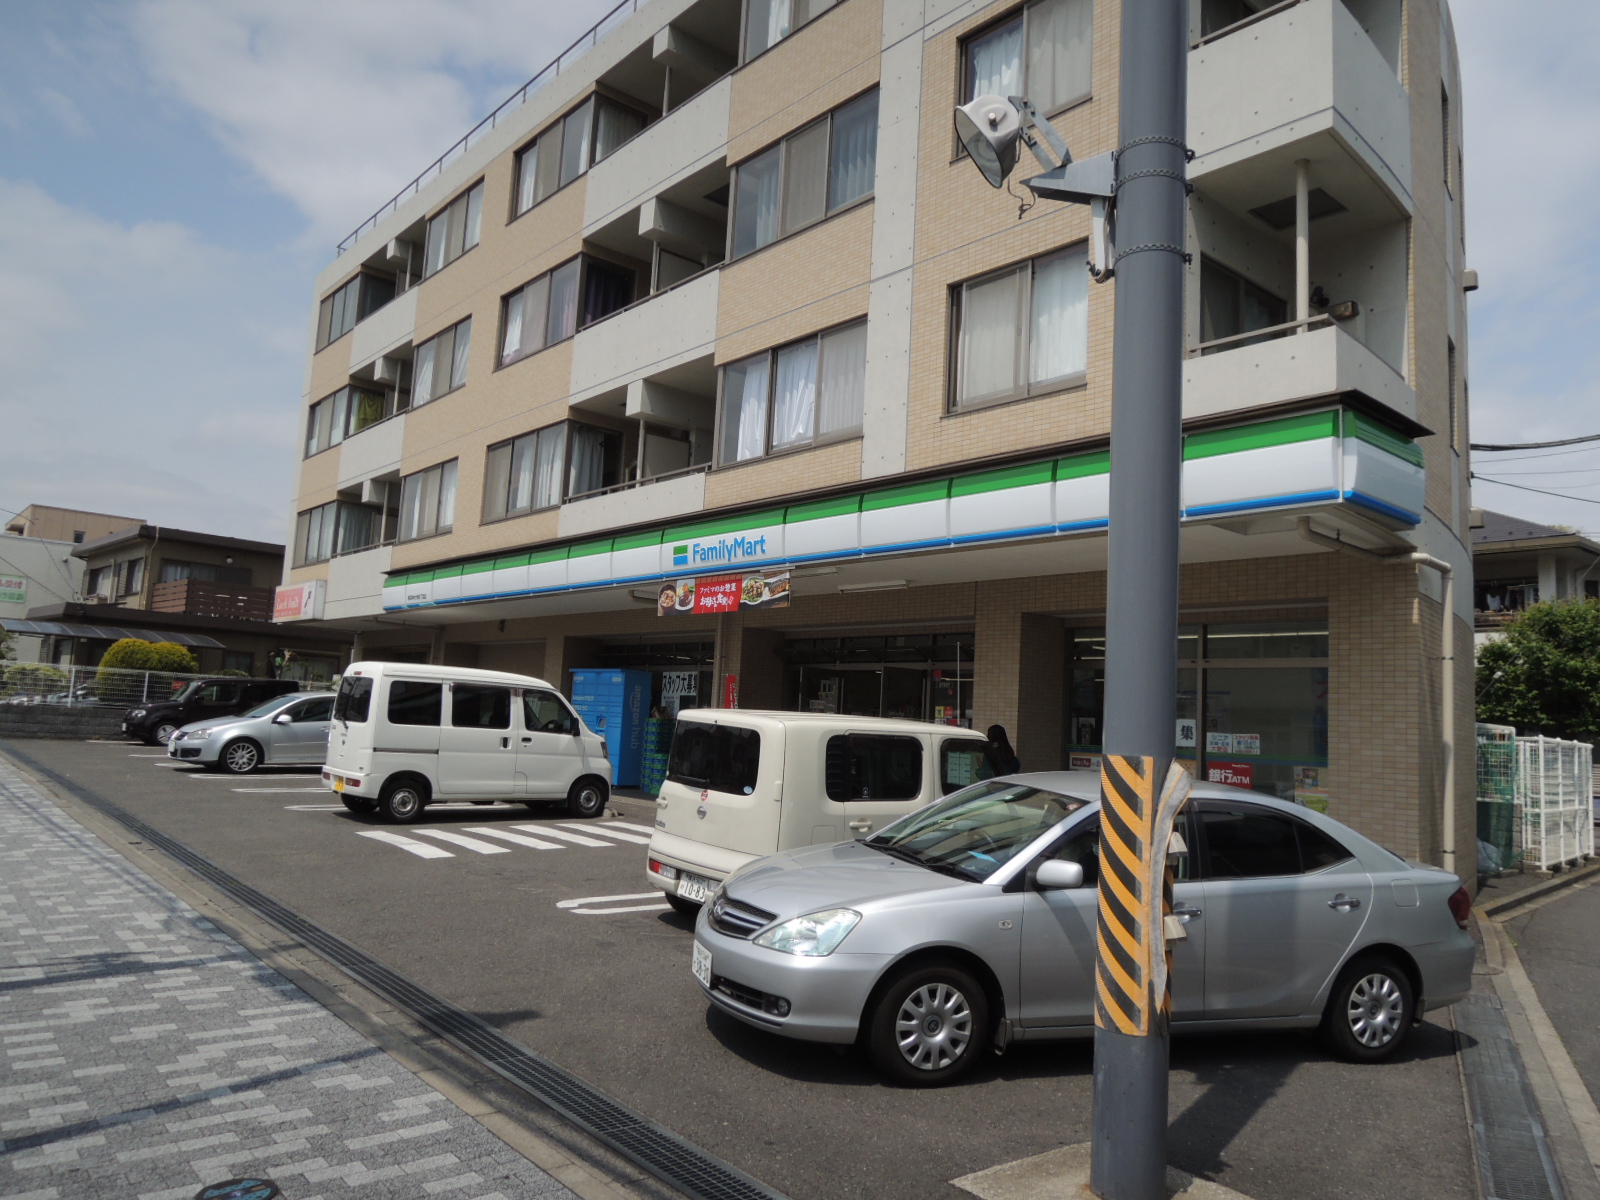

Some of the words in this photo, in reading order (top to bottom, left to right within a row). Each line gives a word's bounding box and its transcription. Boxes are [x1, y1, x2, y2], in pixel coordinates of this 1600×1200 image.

[693, 535, 766, 562] FamilyMart
[699, 582, 737, 594] ファミマのお惣菜
[631, 685, 642, 725] amazon
[631, 727, 641, 749] hub
[1180, 725, 1194, 741] 集
[1209, 769, 1250, 784] 銀行ATM
